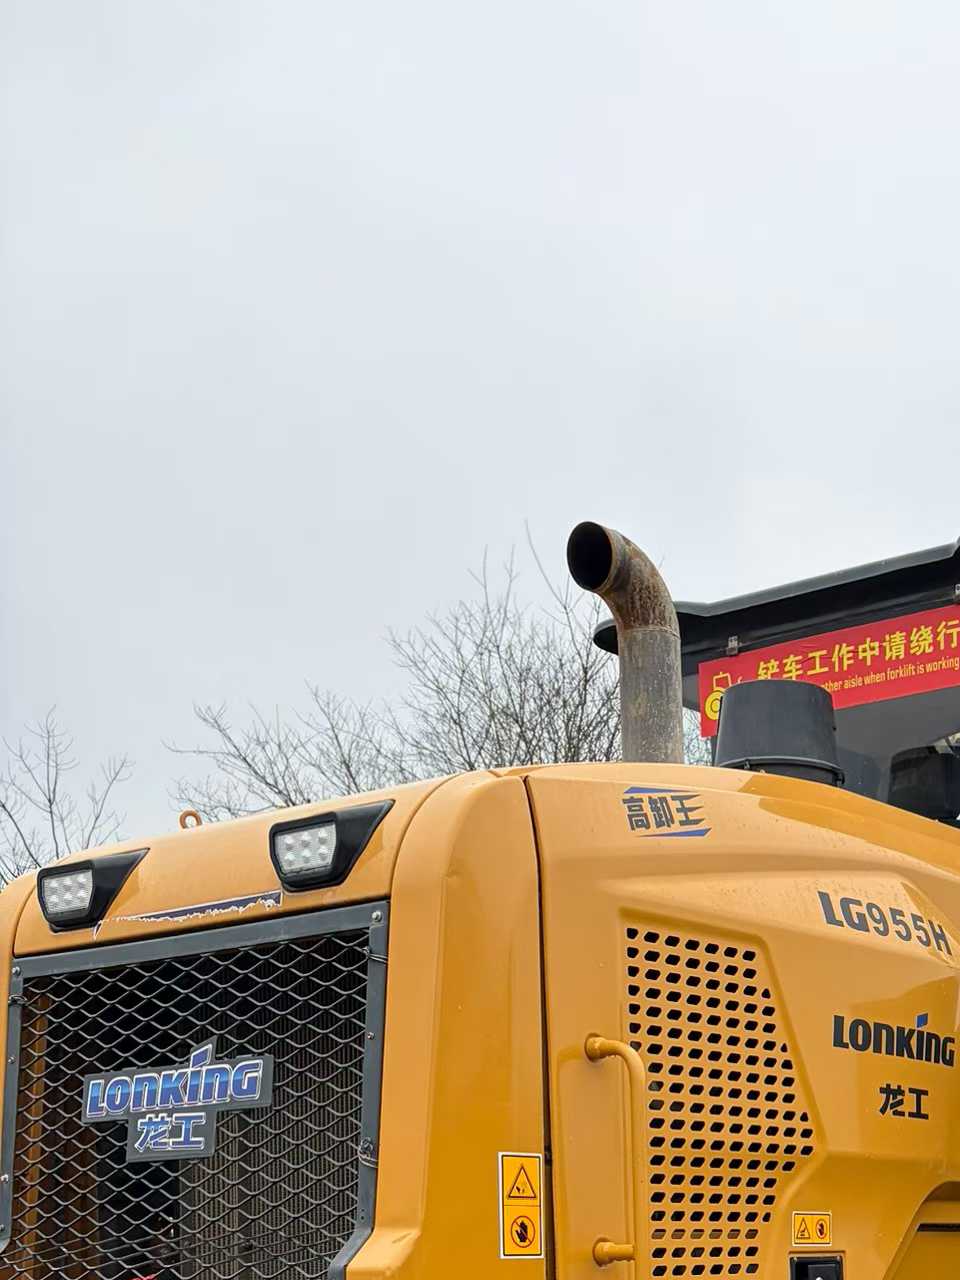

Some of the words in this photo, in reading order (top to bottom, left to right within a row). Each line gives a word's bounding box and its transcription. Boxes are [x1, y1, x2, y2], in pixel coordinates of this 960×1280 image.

[757, 619, 960, 681] 铲车工作中请绕行
[844, 674, 863, 689] aisle
[864, 671, 886, 685] when
[887, 663, 915, 681] forklift
[917, 660, 925, 674] is
[926, 656, 959, 672] working
[817, 891, 952, 956] LG955H
[879, 1083, 929, 1120] 龙工
[135, 1112, 206, 1152] 龙工
